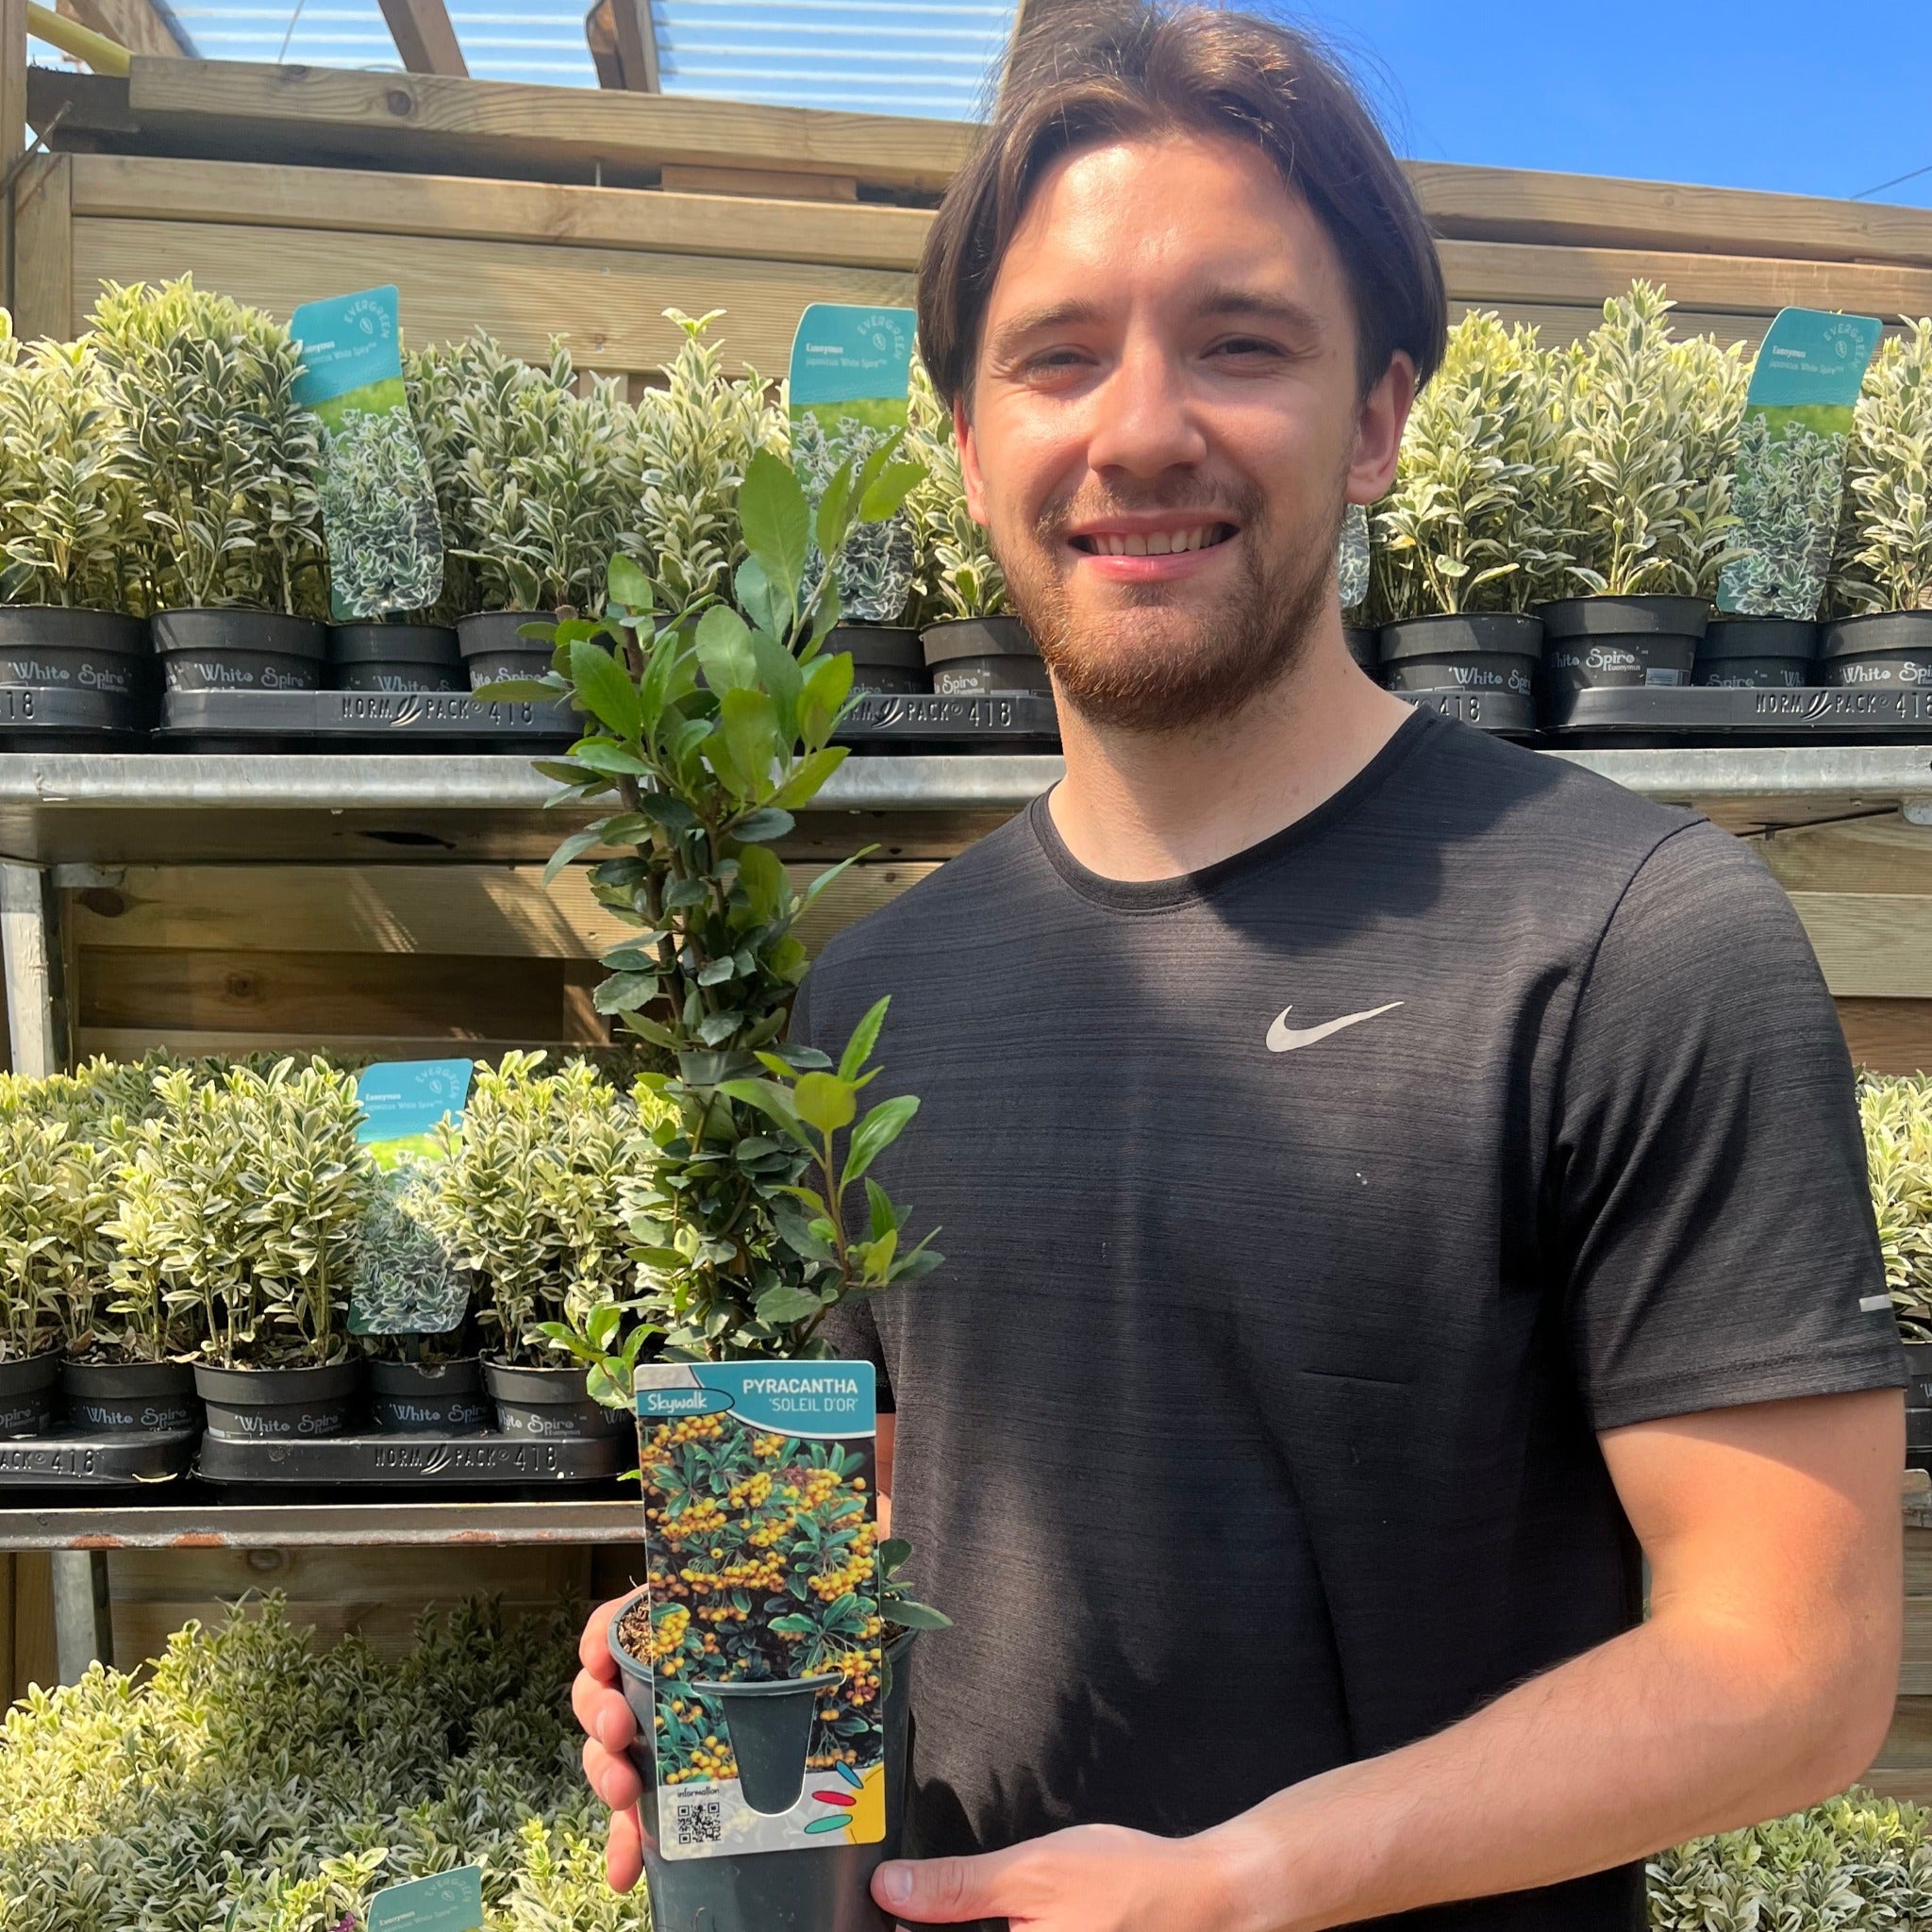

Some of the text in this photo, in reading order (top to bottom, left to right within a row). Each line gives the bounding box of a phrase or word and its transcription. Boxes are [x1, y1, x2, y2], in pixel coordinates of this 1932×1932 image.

[343, 300, 391, 339] EVERGREEN
[857, 315, 906, 359] EVERGREEN
[1823, 323, 1865, 368] EVERGREEN
[1508, 669, 1531, 691] Spir
[1898, 661, 1932, 685] Spi
[0, 691, 34, 720] 18
[342, 696, 394, 719] NORM
[489, 699, 535, 725] 418
[969, 699, 1012, 727] 418
[1440, 696, 1481, 723] 418
[1756, 692, 1804, 714] NORM
[742, 1378, 858, 1394] PYRACANTHA
[647, 1391, 708, 1414] Skywalk
[0, 1449, 94, 1475] ACK® 418
[375, 1447, 423, 1467] NORM
[515, 1446, 558, 1471] 418
[677, 1786, 720, 1798] information
